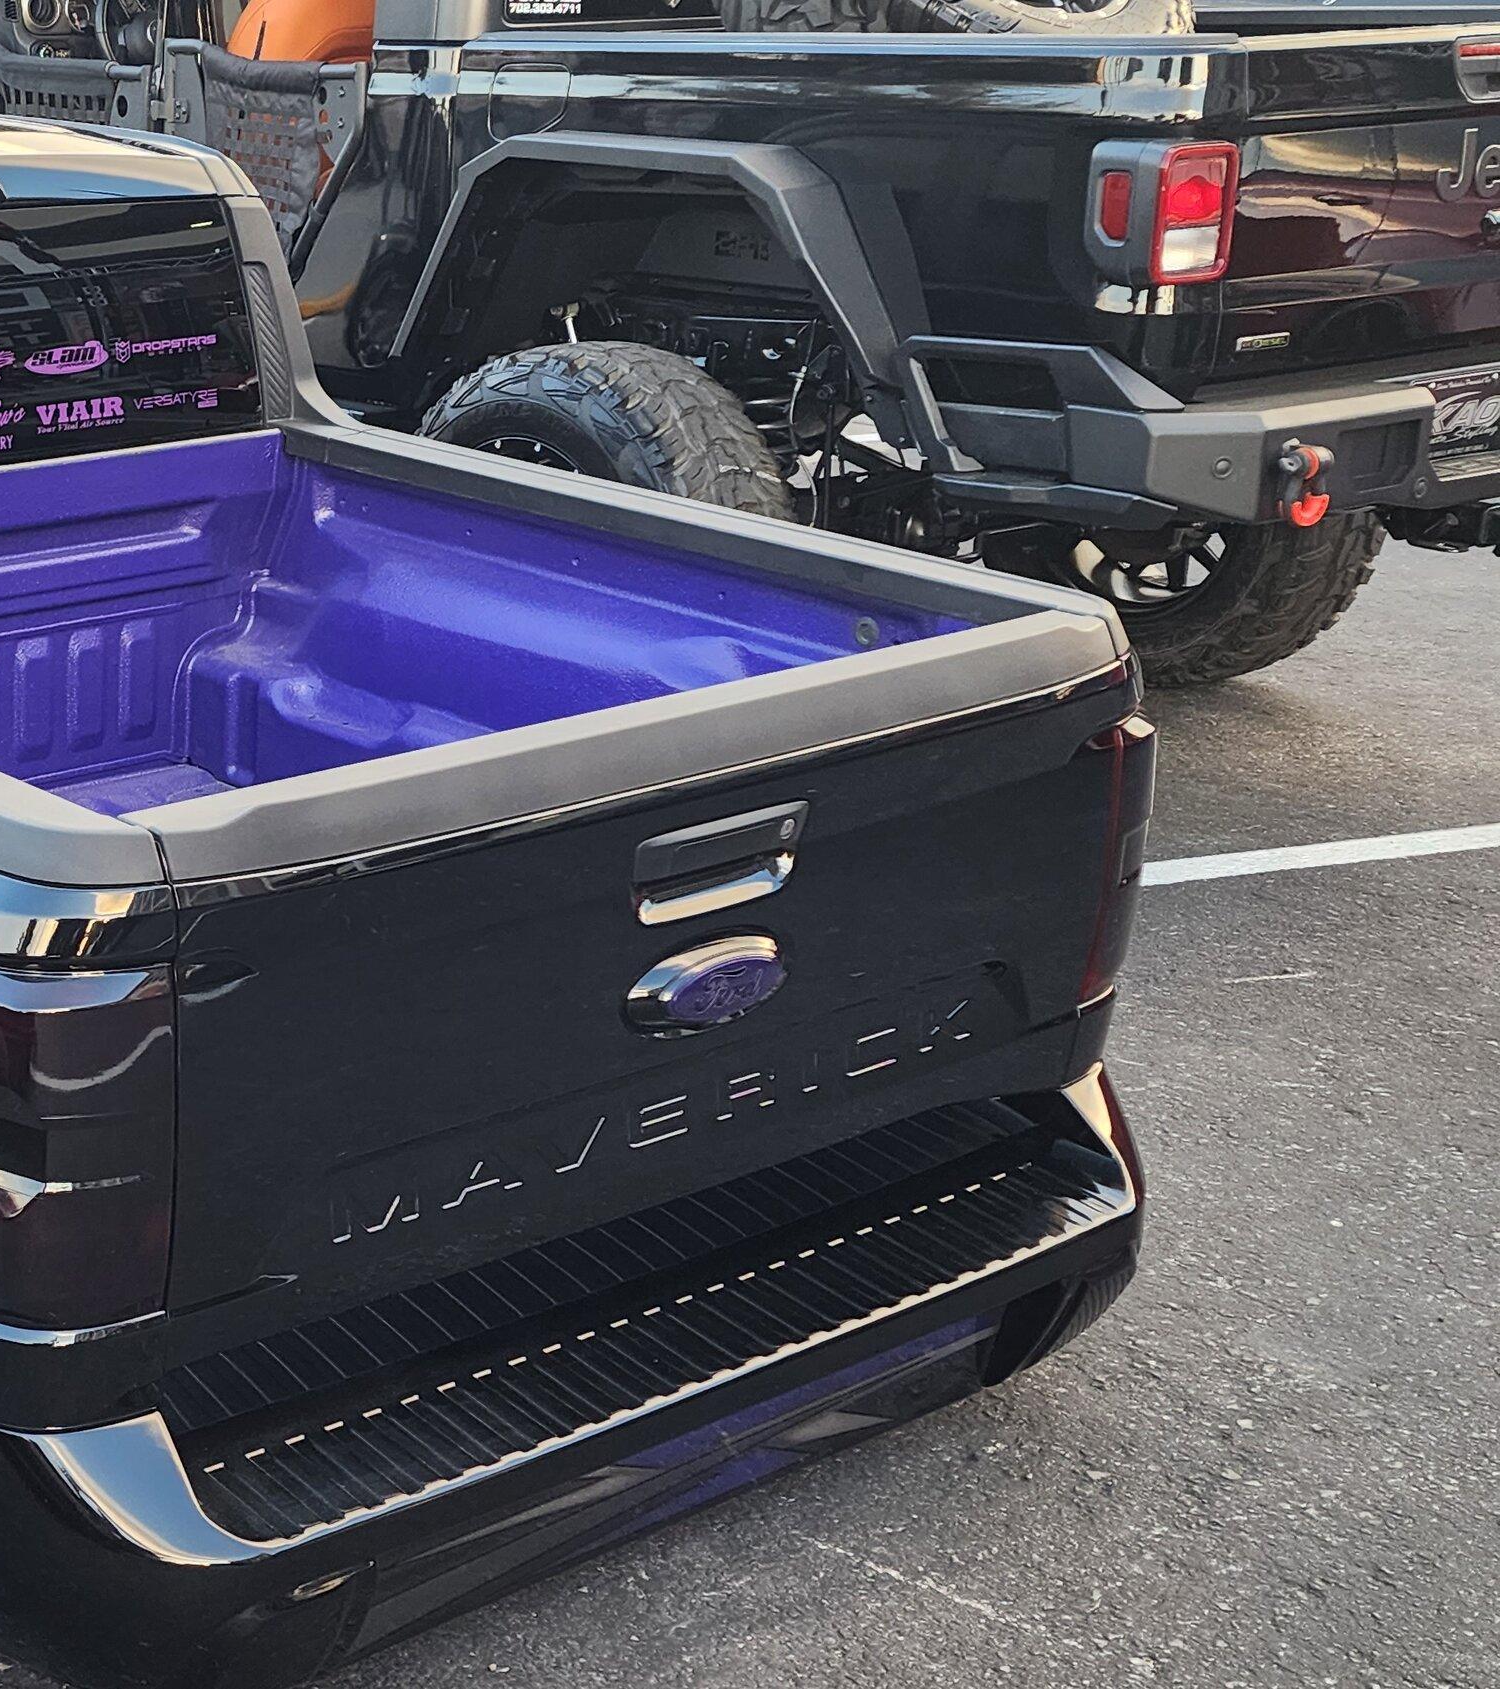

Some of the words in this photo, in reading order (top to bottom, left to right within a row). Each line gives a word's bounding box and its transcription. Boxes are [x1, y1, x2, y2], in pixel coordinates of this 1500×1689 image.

[508, 2, 582, 15] 702.303.4711
[132, 334, 217, 354] DROPSTARS
[35, 396, 125, 426] VIAIR
[133, 388, 218, 410] VERSATYRE
[696, 965, 764, 1015] Ford
[332, 1000, 972, 1244] MAVERICK
